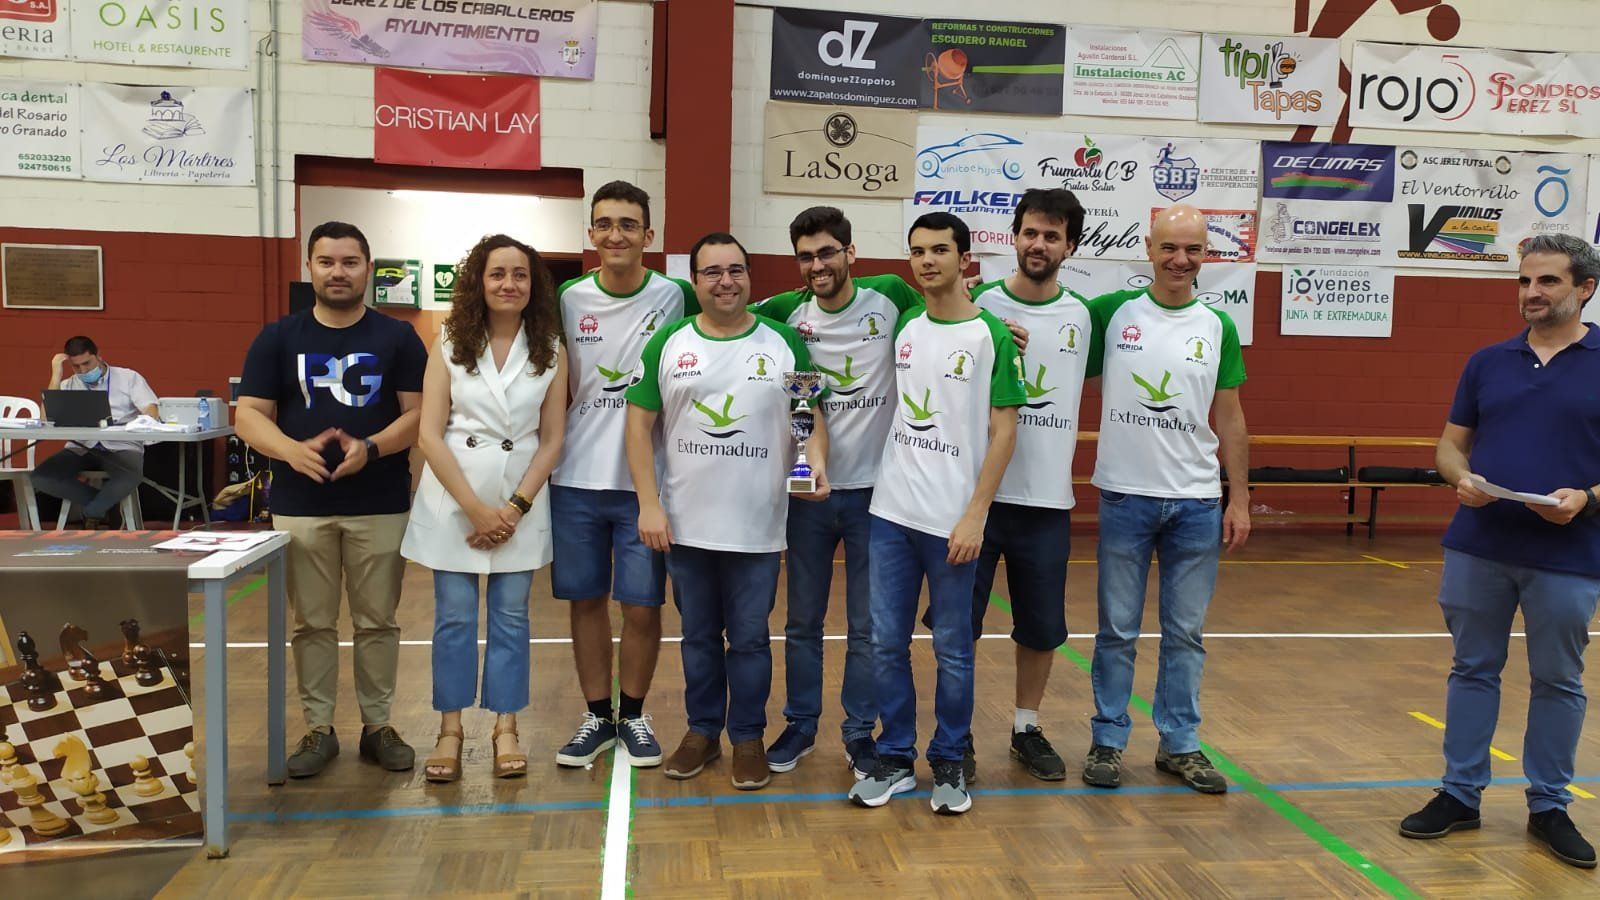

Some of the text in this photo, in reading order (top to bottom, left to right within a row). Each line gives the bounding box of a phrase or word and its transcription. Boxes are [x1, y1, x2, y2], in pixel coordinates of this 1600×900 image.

[99, 2, 226, 33] OASIS
[421, 1, 458, 13] LOS
[461, 2, 575, 23] CABALLEROS
[384, 18, 540, 43] AYUNTAMIENTO
[932, 22, 1055, 36] REFORMAS Y CONSTRUCCIONES
[93, 40, 232, 58] HOTEL & RESTAURENTE
[931, 34, 1028, 48] ESCUDERO RANGEL
[1090, 44, 1127, 52] Instalaciones
[1219, 38, 1271, 89] tipi
[1076, 65, 1186, 81] Instalaciones AC
[21, 90, 67, 104] dental
[1247, 81, 1322, 120] Tapas
[1558, 98, 1578, 114] SL
[17, 108, 67, 121] Rosario
[12, 124, 67, 137] Granado
[494, 112, 539, 135] LAY
[18, 153, 71, 163] 652033230
[96, 144, 137, 171] Los
[1273, 155, 1386, 171] DECIMAS
[1422, 157, 1494, 168] ASC JEREZ FUTSAL
[18, 163, 71, 172] 924750615
[1154, 168, 1200, 185] SBF
[1401, 180, 1521, 201] El Ventorrillo
[1294, 220, 1380, 236] CONGELEX
[1320, 268, 1369, 277] fundación
[1316, 292, 1389, 305] ydeporte
[1286, 310, 1388, 321] JUNTA DE EXTREMADURA
[1110, 408, 1196, 434] Extremadura
[678, 438, 768, 459] Extremadura
